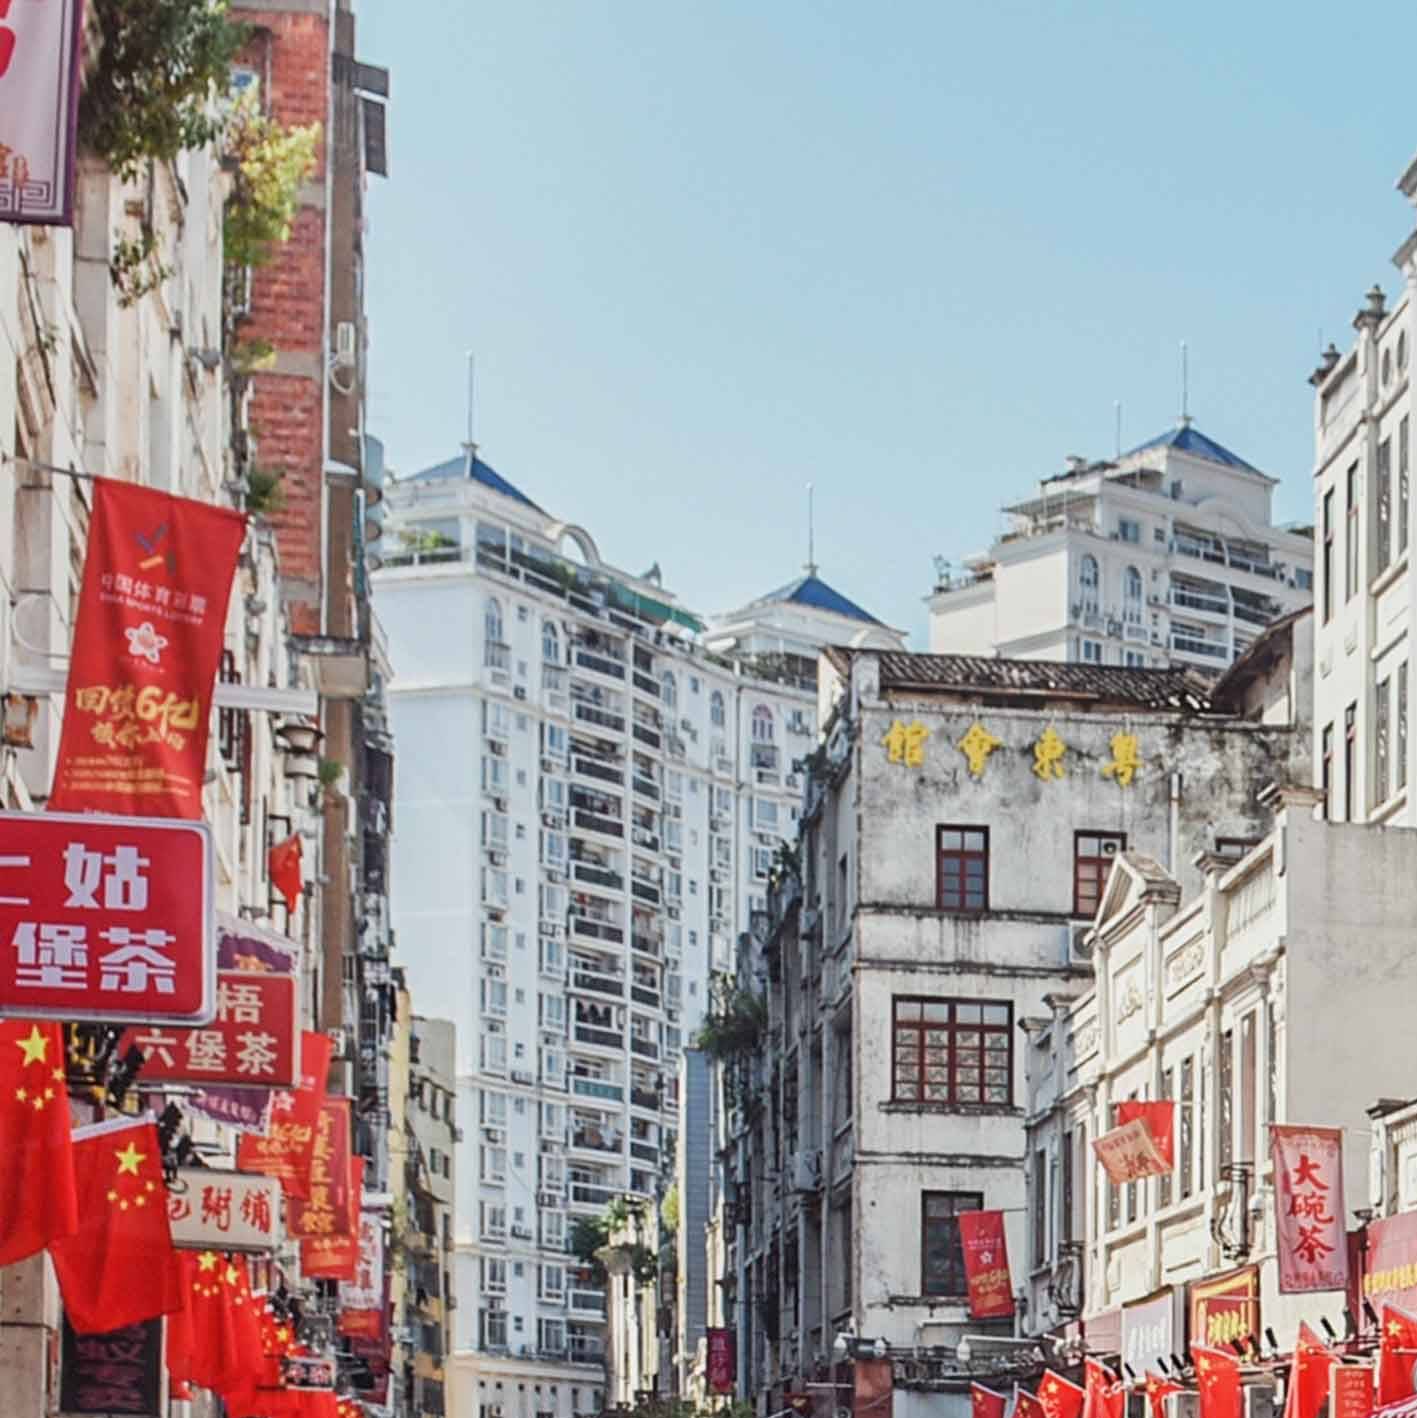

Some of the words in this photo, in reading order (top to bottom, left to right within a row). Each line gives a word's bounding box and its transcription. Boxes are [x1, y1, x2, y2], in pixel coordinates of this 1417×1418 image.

[12, 921, 177, 993] 堡茶
[135, 1026, 279, 1075] 六堡茶
[1286, 1153, 1336, 1264] 大碗茶
